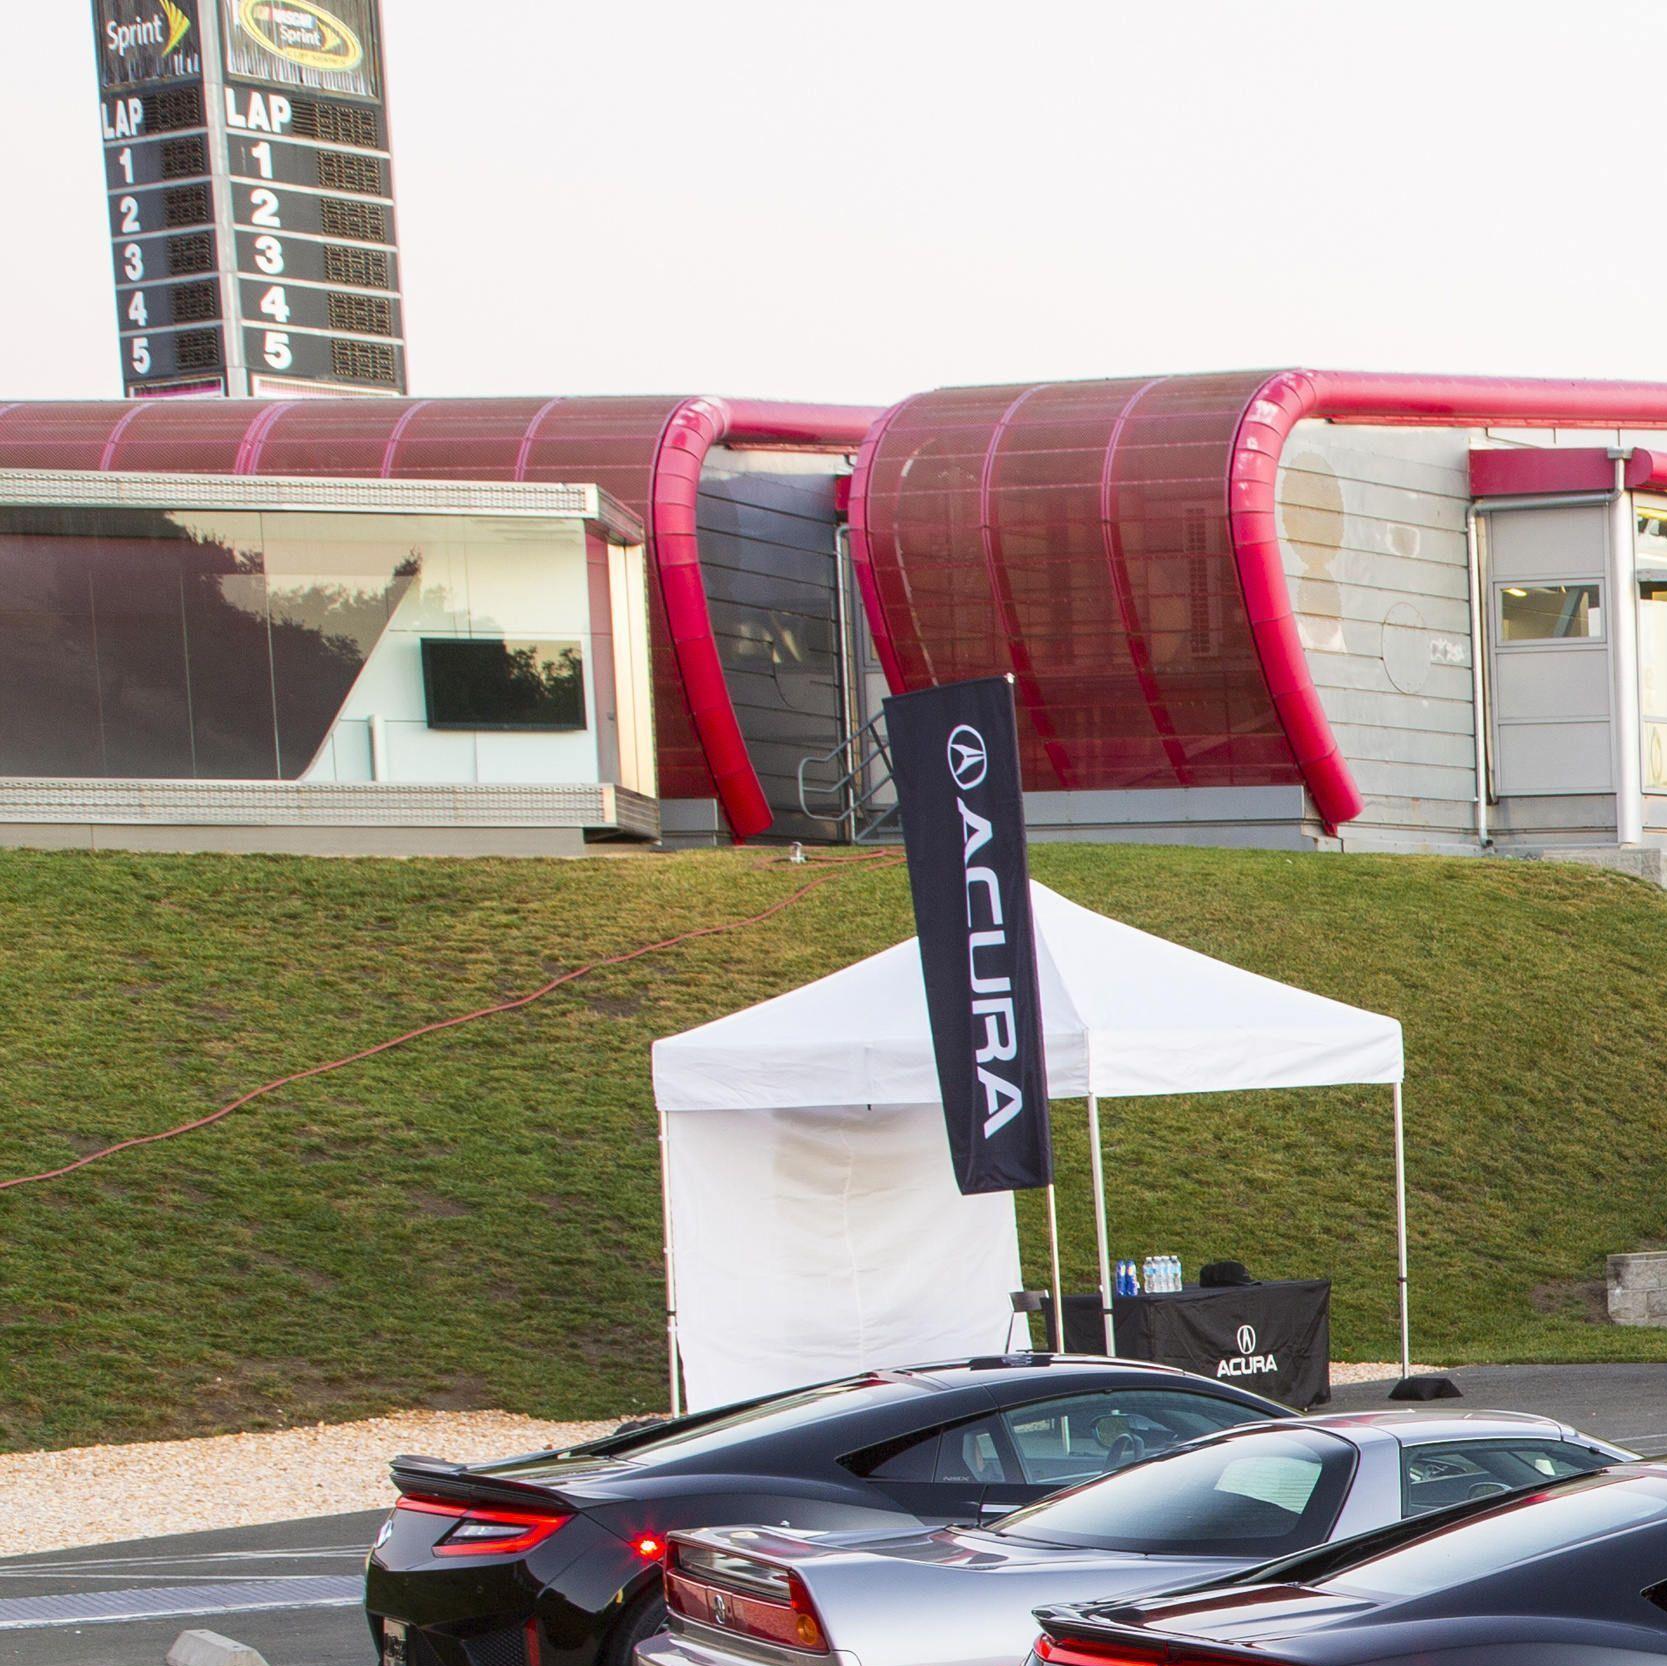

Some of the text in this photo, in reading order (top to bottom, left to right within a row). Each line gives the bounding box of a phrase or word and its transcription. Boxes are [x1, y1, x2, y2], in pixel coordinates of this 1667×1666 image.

[106, 14, 164, 57] Sprint
[280, 25, 322, 46] Sprint
[101, 98, 143, 140] LAP
[224, 87, 292, 133] LAP
[119, 148, 134, 183] 1
[251, 141, 273, 179] 1
[120, 196, 140, 233] 2
[250, 188, 281, 228] 2
[124, 243, 144, 281] 3
[254, 235, 285, 275] 3
[128, 291, 147, 326] 4
[260, 285, 291, 323] 4
[132, 337, 151, 374] 5
[263, 332, 293, 370] 5
[956, 796, 1023, 1140] ACURA
[1216, 1353, 1278, 1378] ACURA
